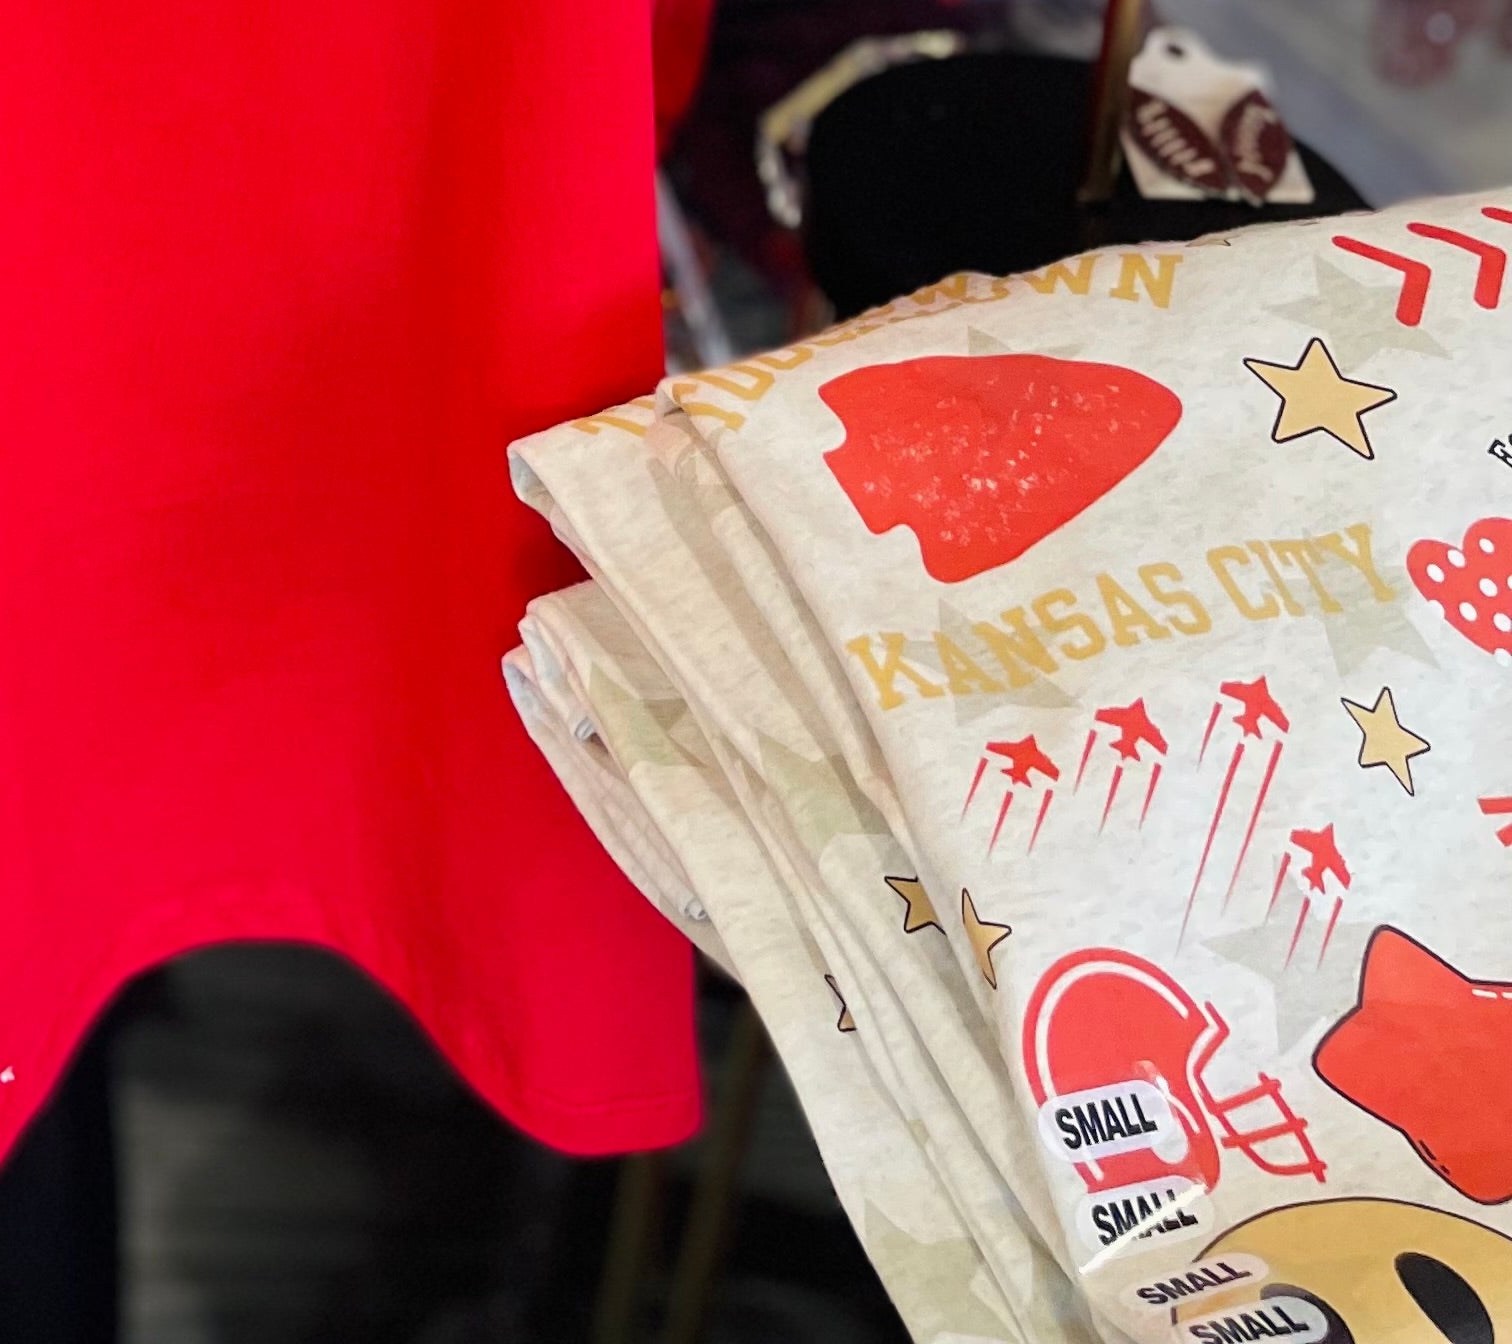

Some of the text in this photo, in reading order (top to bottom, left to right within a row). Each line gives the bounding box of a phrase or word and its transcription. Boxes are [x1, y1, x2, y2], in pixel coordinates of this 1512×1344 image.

[846, 523, 1400, 711] KANSAS CITY
[1055, 1092, 1159, 1150] SMALL
[1136, 1261, 1253, 1305] SMALL
[1189, 1305, 1311, 1344] SMALL
